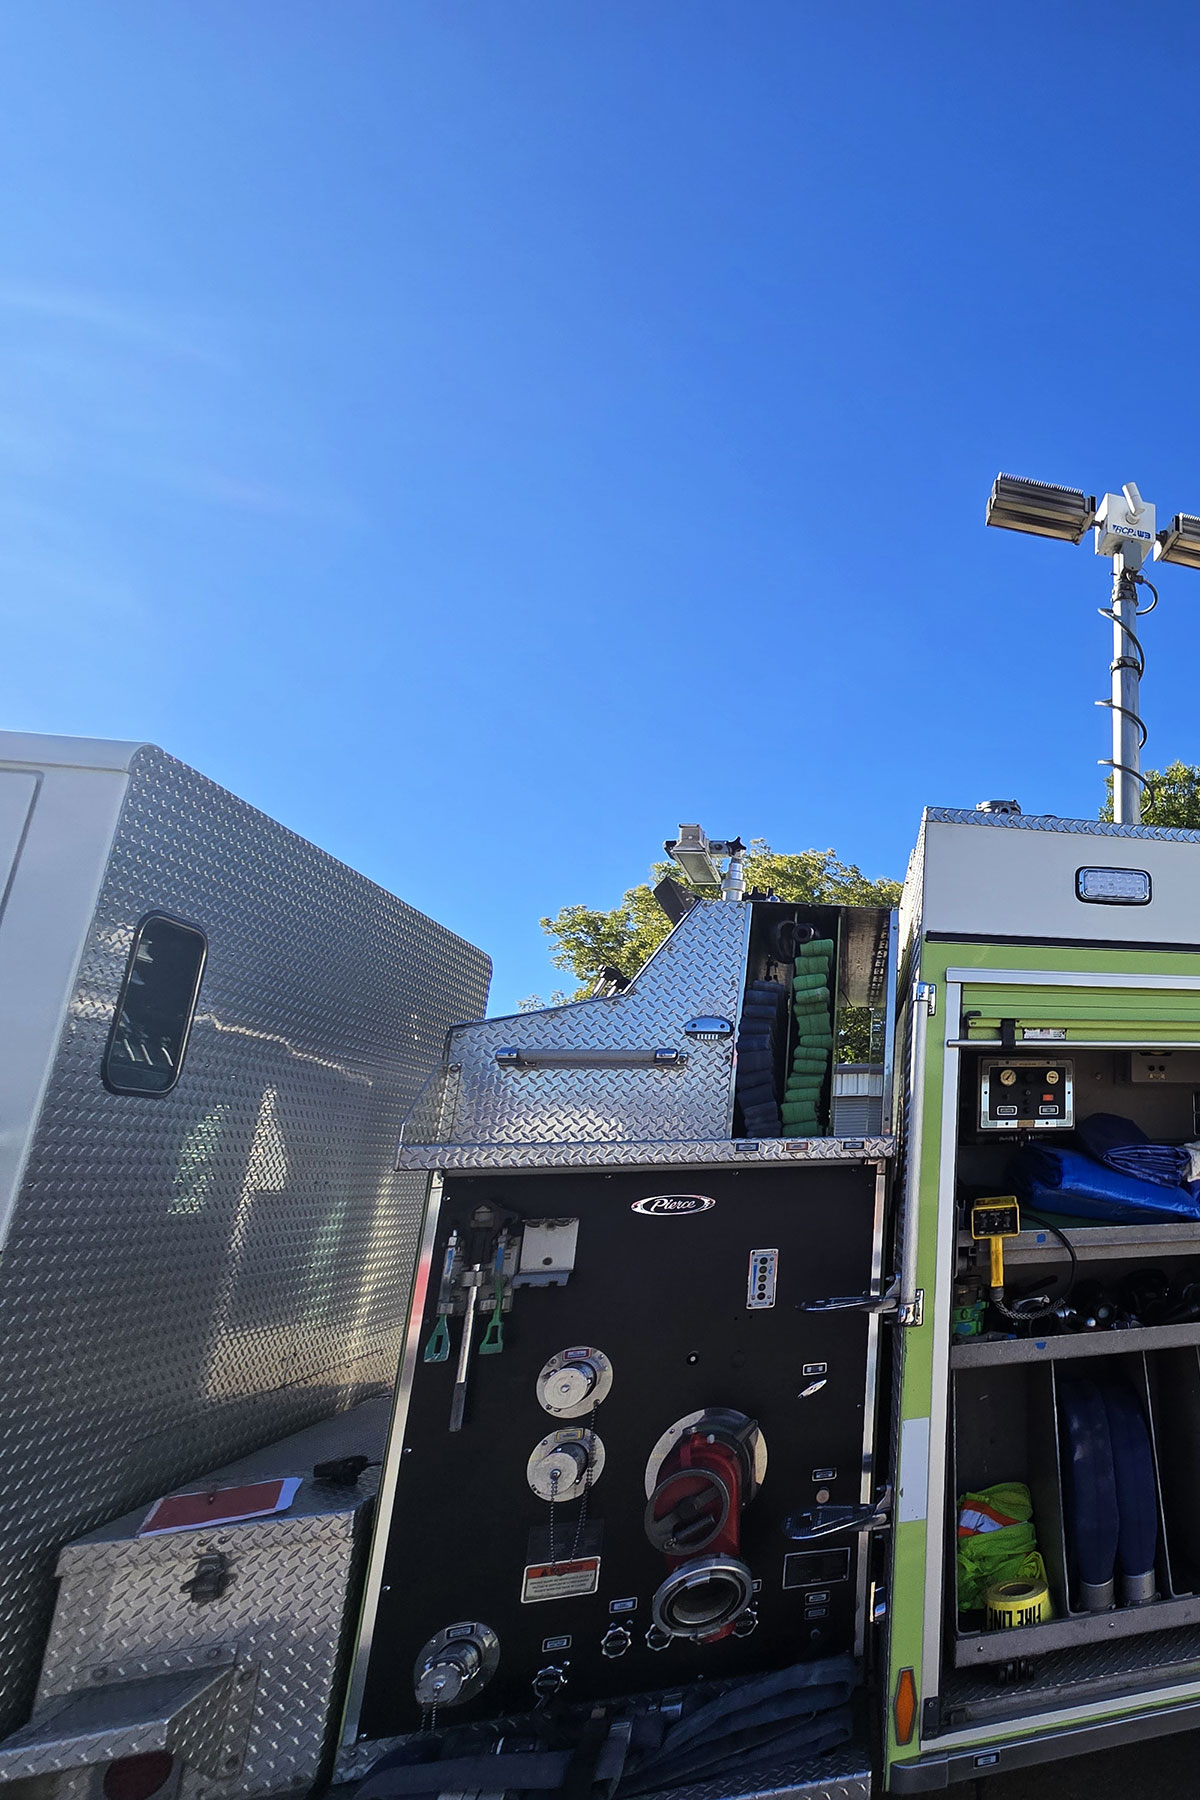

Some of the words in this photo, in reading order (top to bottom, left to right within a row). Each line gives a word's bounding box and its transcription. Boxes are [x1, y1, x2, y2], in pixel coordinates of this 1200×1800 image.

[650, 1198, 697, 1212] Pierce
[987, 1607, 1013, 1629] LINE
[1017, 1604, 1042, 1627] FIRE
